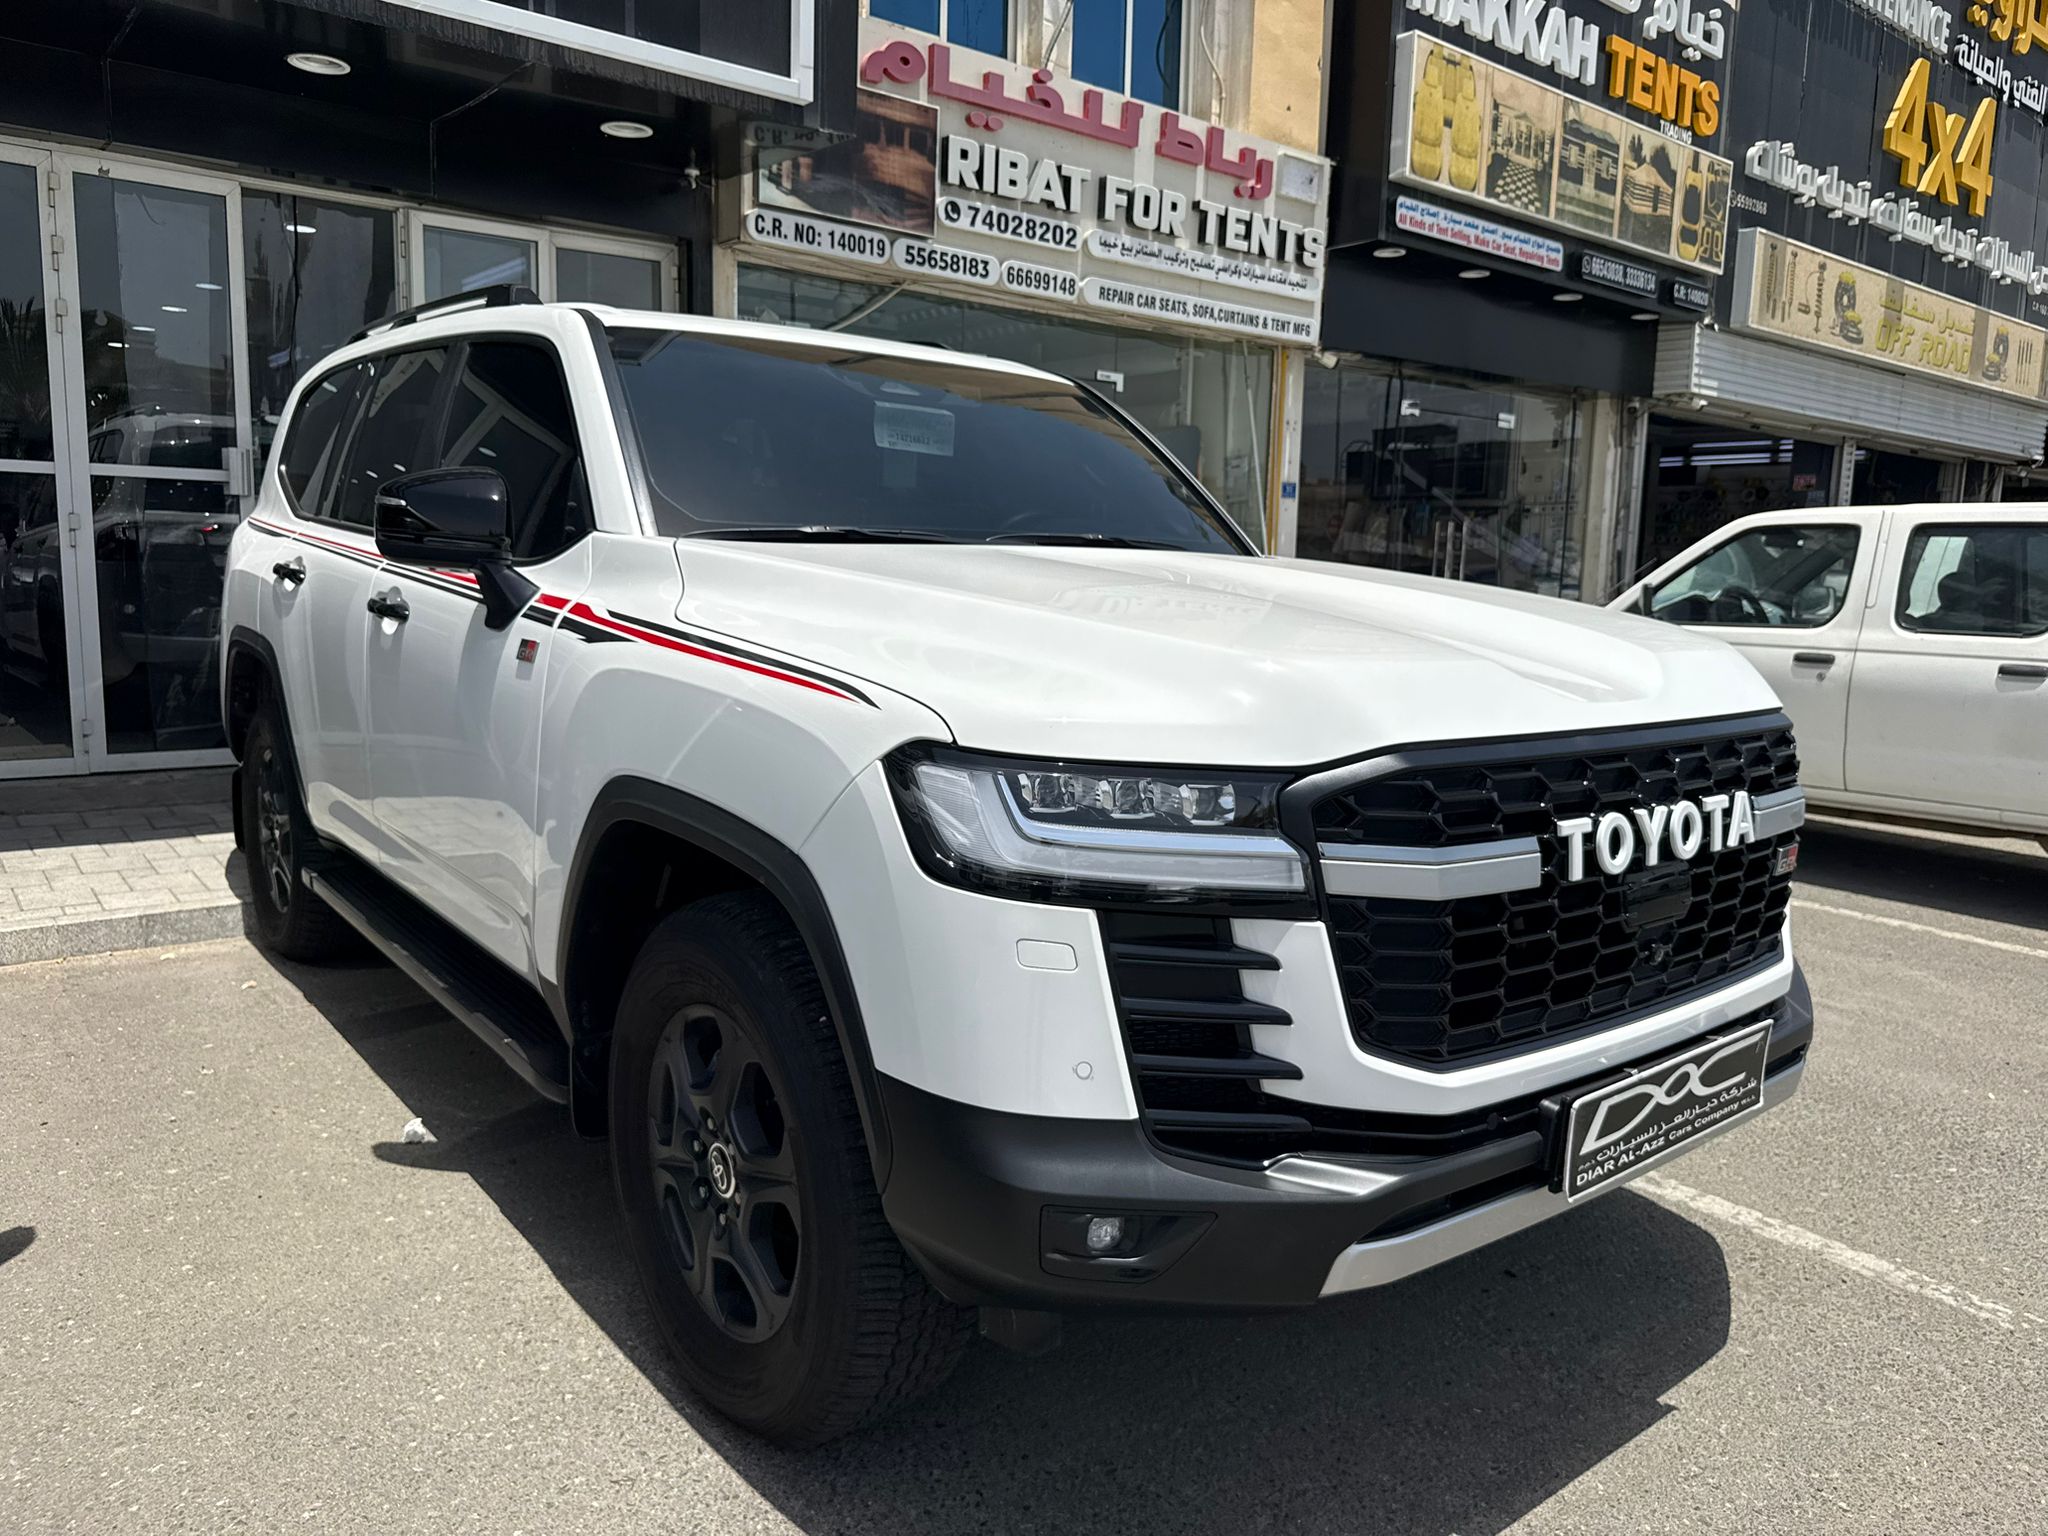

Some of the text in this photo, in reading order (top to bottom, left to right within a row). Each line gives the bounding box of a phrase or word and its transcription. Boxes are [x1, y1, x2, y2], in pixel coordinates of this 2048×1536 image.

[1606, 34, 1720, 136] TENTS
[860, 40, 1274, 200] رباط للخيام
[1659, 119, 1692, 144] TRADING
[945, 134, 1326, 270] RIBAT FOR TENTS
[966, 205, 1078, 249] 74028202
[754, 213, 886, 259] C.R. NO: 140019
[904, 243, 990, 280] 55658183
[1398, 212, 1407, 225] All
[1408, 214, 1426, 231] Kinds
[1427, 220, 1434, 232] of
[1435, 223, 1449, 237] Tent
[1473, 232, 1490, 249] Make
[1491, 238, 1502, 251] Car
[1518, 246, 1545, 267] Repairing
[1545, 254, 1560, 269] Tents
[1006, 265, 1077, 298] 66699148
[1099, 285, 1134, 306] REPAIR
[1136, 293, 1157, 311] CAR
[1158, 297, 1190, 317] SEATS,
[1261, 318, 1269, 329] &
[1270, 320, 1291, 334] TENT
[1292, 323, 1311, 337] MFG
[1874, 318, 1973, 374] OFF ROAD
[1556, 790, 1756, 882] TOYOTA
[1719, 1077, 1758, 1103] شركة
[1576, 1160, 1616, 1187] DIAR
[1668, 1124, 1692, 1141] Cars
[1694, 1102, 1739, 1128] Company
[1596, 1122, 1660, 1162] للسيارات
